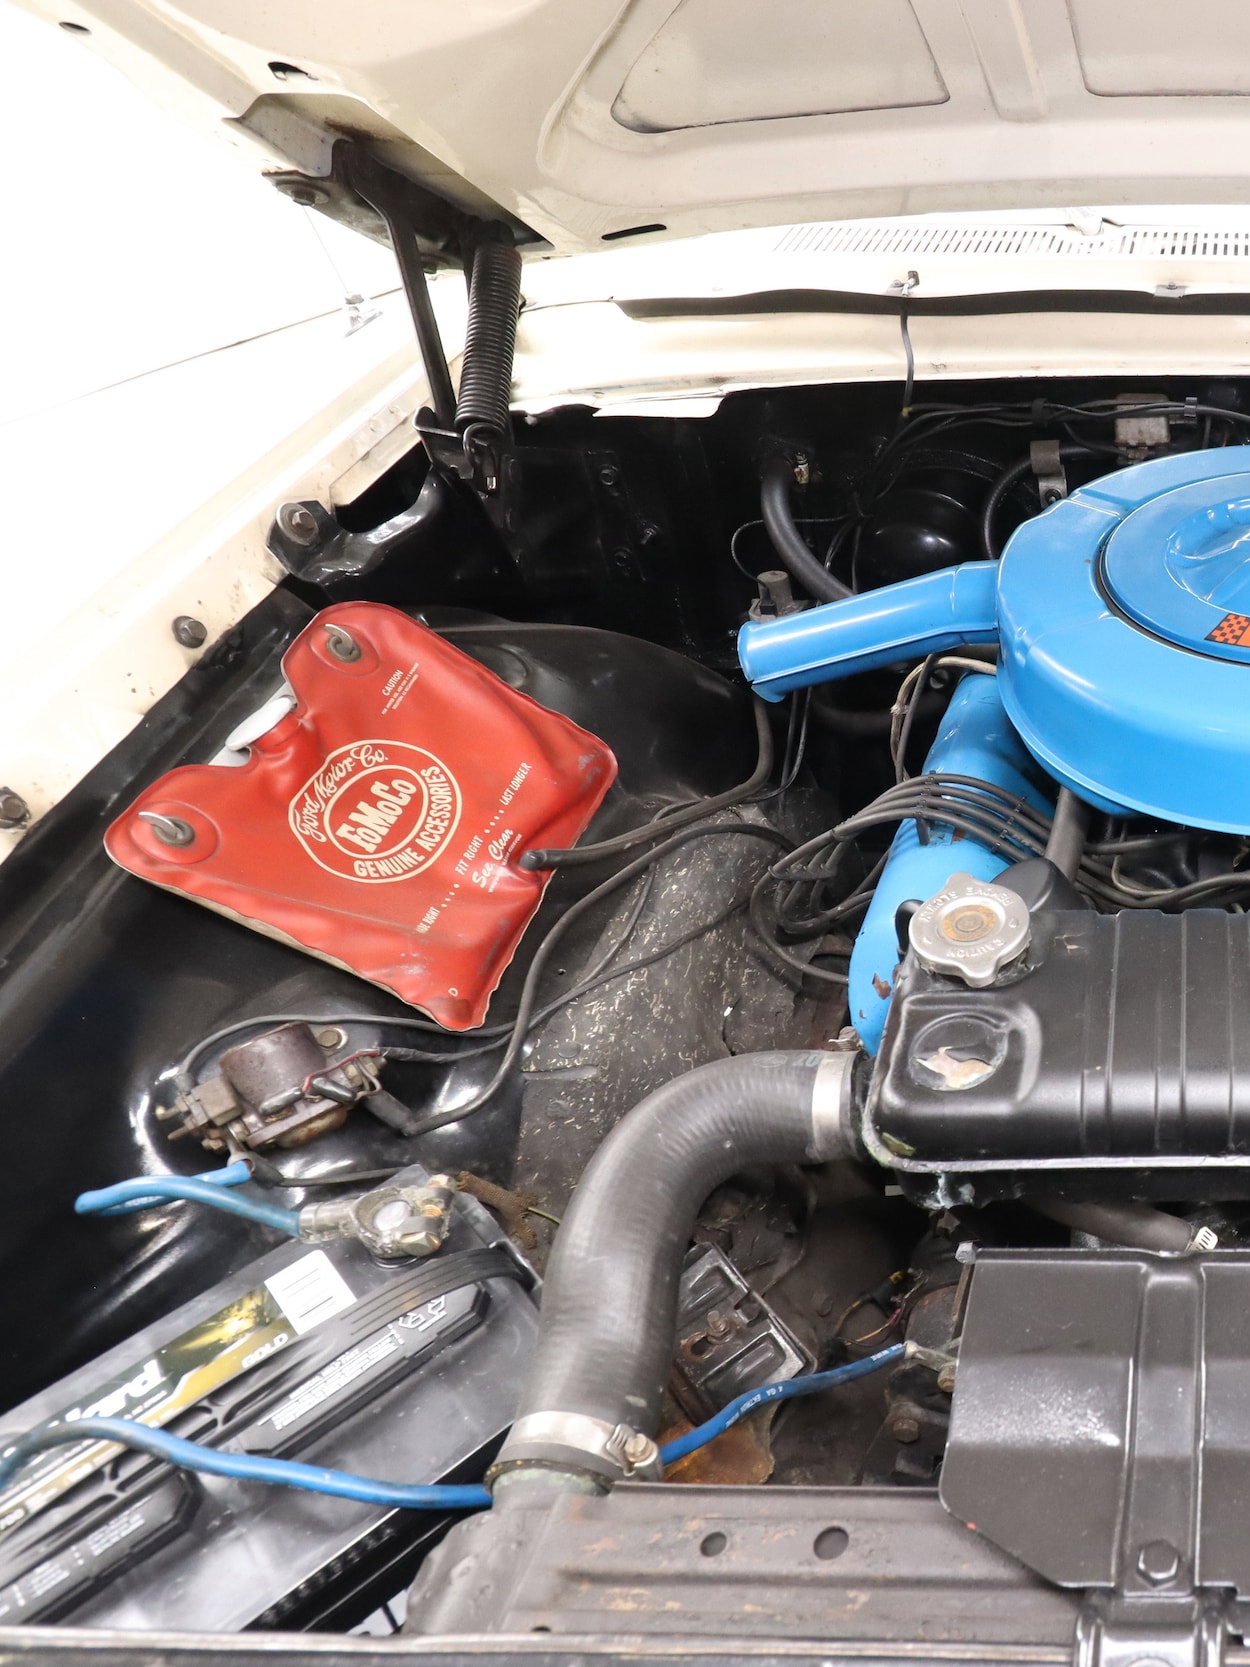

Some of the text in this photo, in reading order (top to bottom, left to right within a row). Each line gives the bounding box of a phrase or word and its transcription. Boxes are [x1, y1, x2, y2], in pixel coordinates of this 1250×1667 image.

[382, 669, 404, 696] CAUTION
[294, 744, 389, 843] Ford Motor Co.
[335, 778, 417, 853] FoMoCo
[353, 765, 453, 878] GENUINE ACCESSORIES
[422, 906, 441, 926] RIGHT
[454, 856, 470, 876] FIT
[463, 834, 485, 862] RIGHT
[498, 787, 515, 806] LAST
[509, 762, 533, 791] LONGER
[471, 862, 494, 889] See
[487, 828, 514, 861] Clear
[241, 1333, 288, 1369] GOLD
[766, 1388, 777, 1397] GA
[778, 1385, 783, 1393] 4
